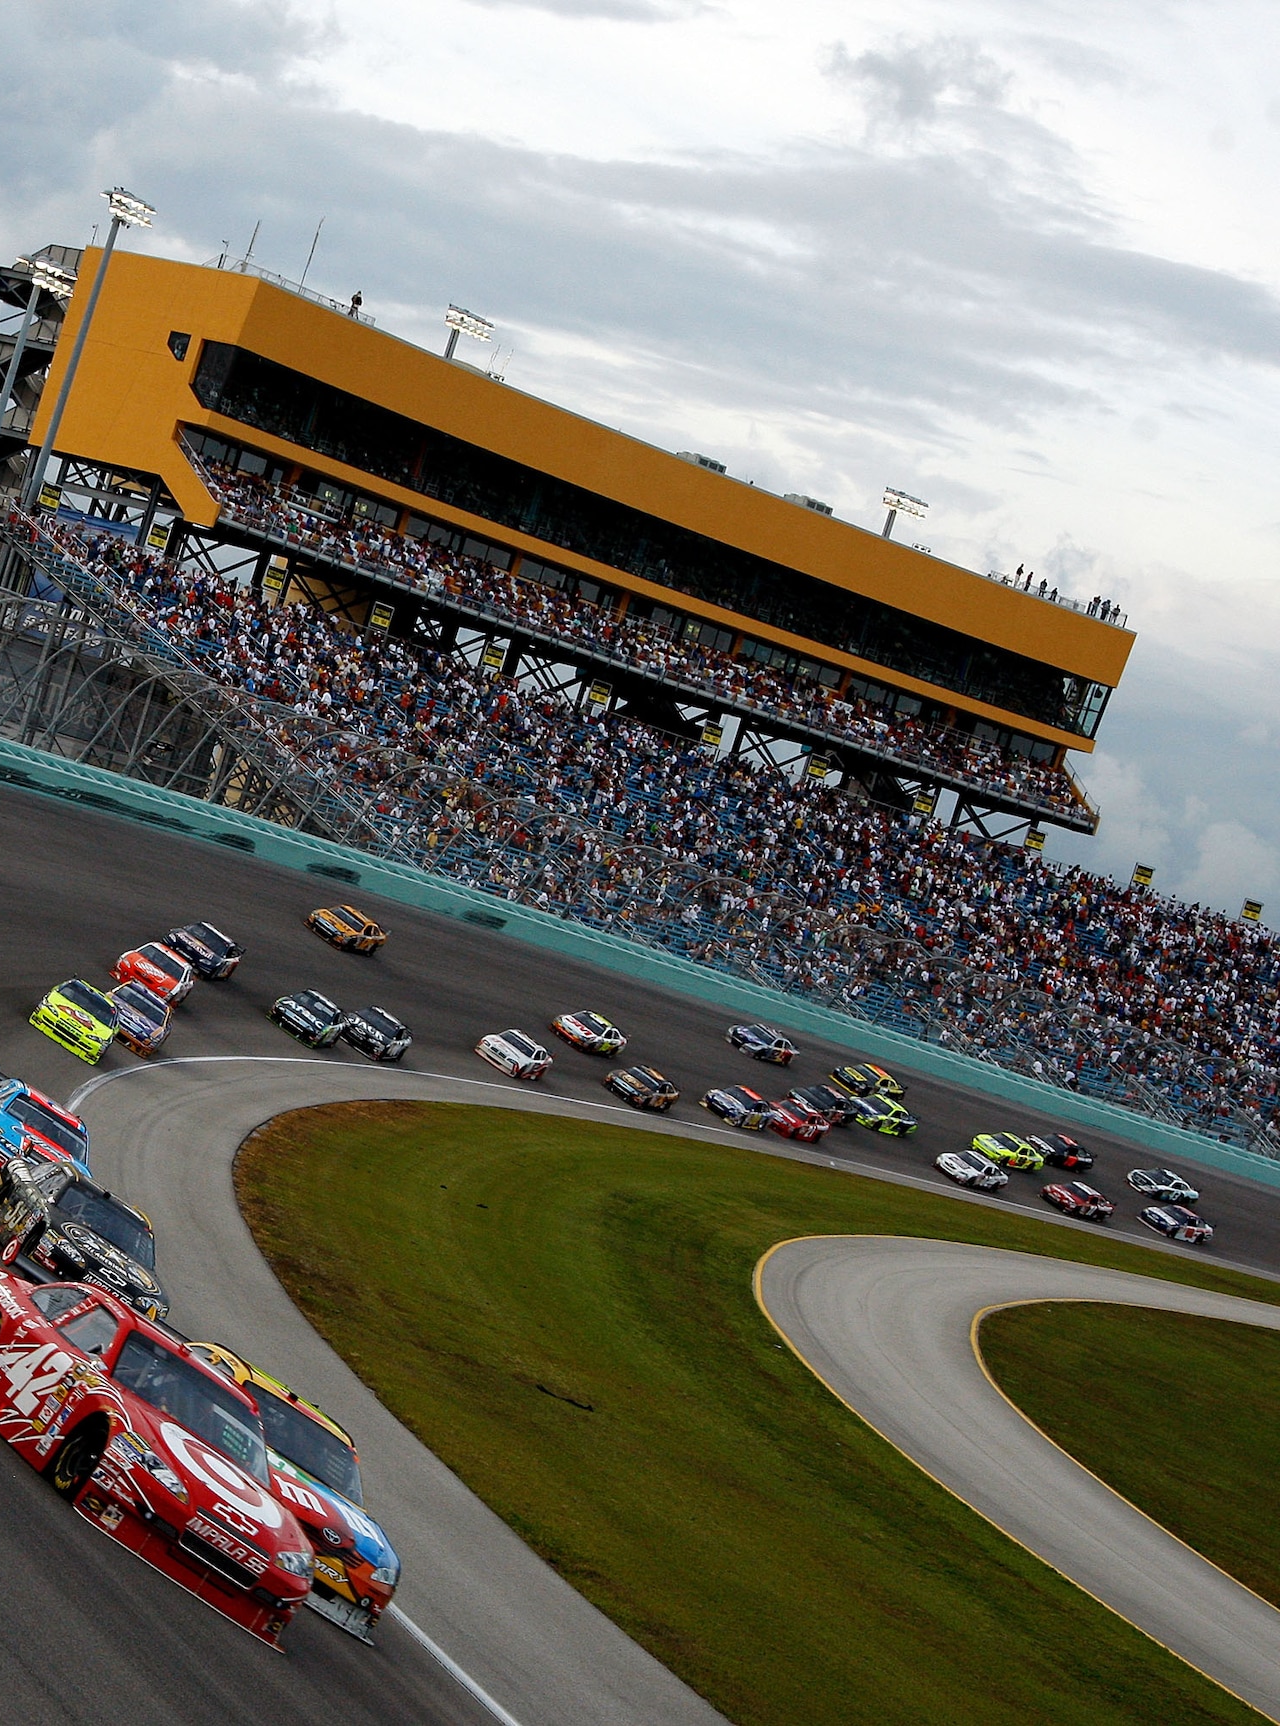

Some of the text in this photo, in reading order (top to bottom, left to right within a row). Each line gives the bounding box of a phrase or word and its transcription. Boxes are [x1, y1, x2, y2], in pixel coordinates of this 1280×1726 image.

[5, 1342, 74, 1418] 42
[186, 1516, 270, 1575] IMPALA SS
